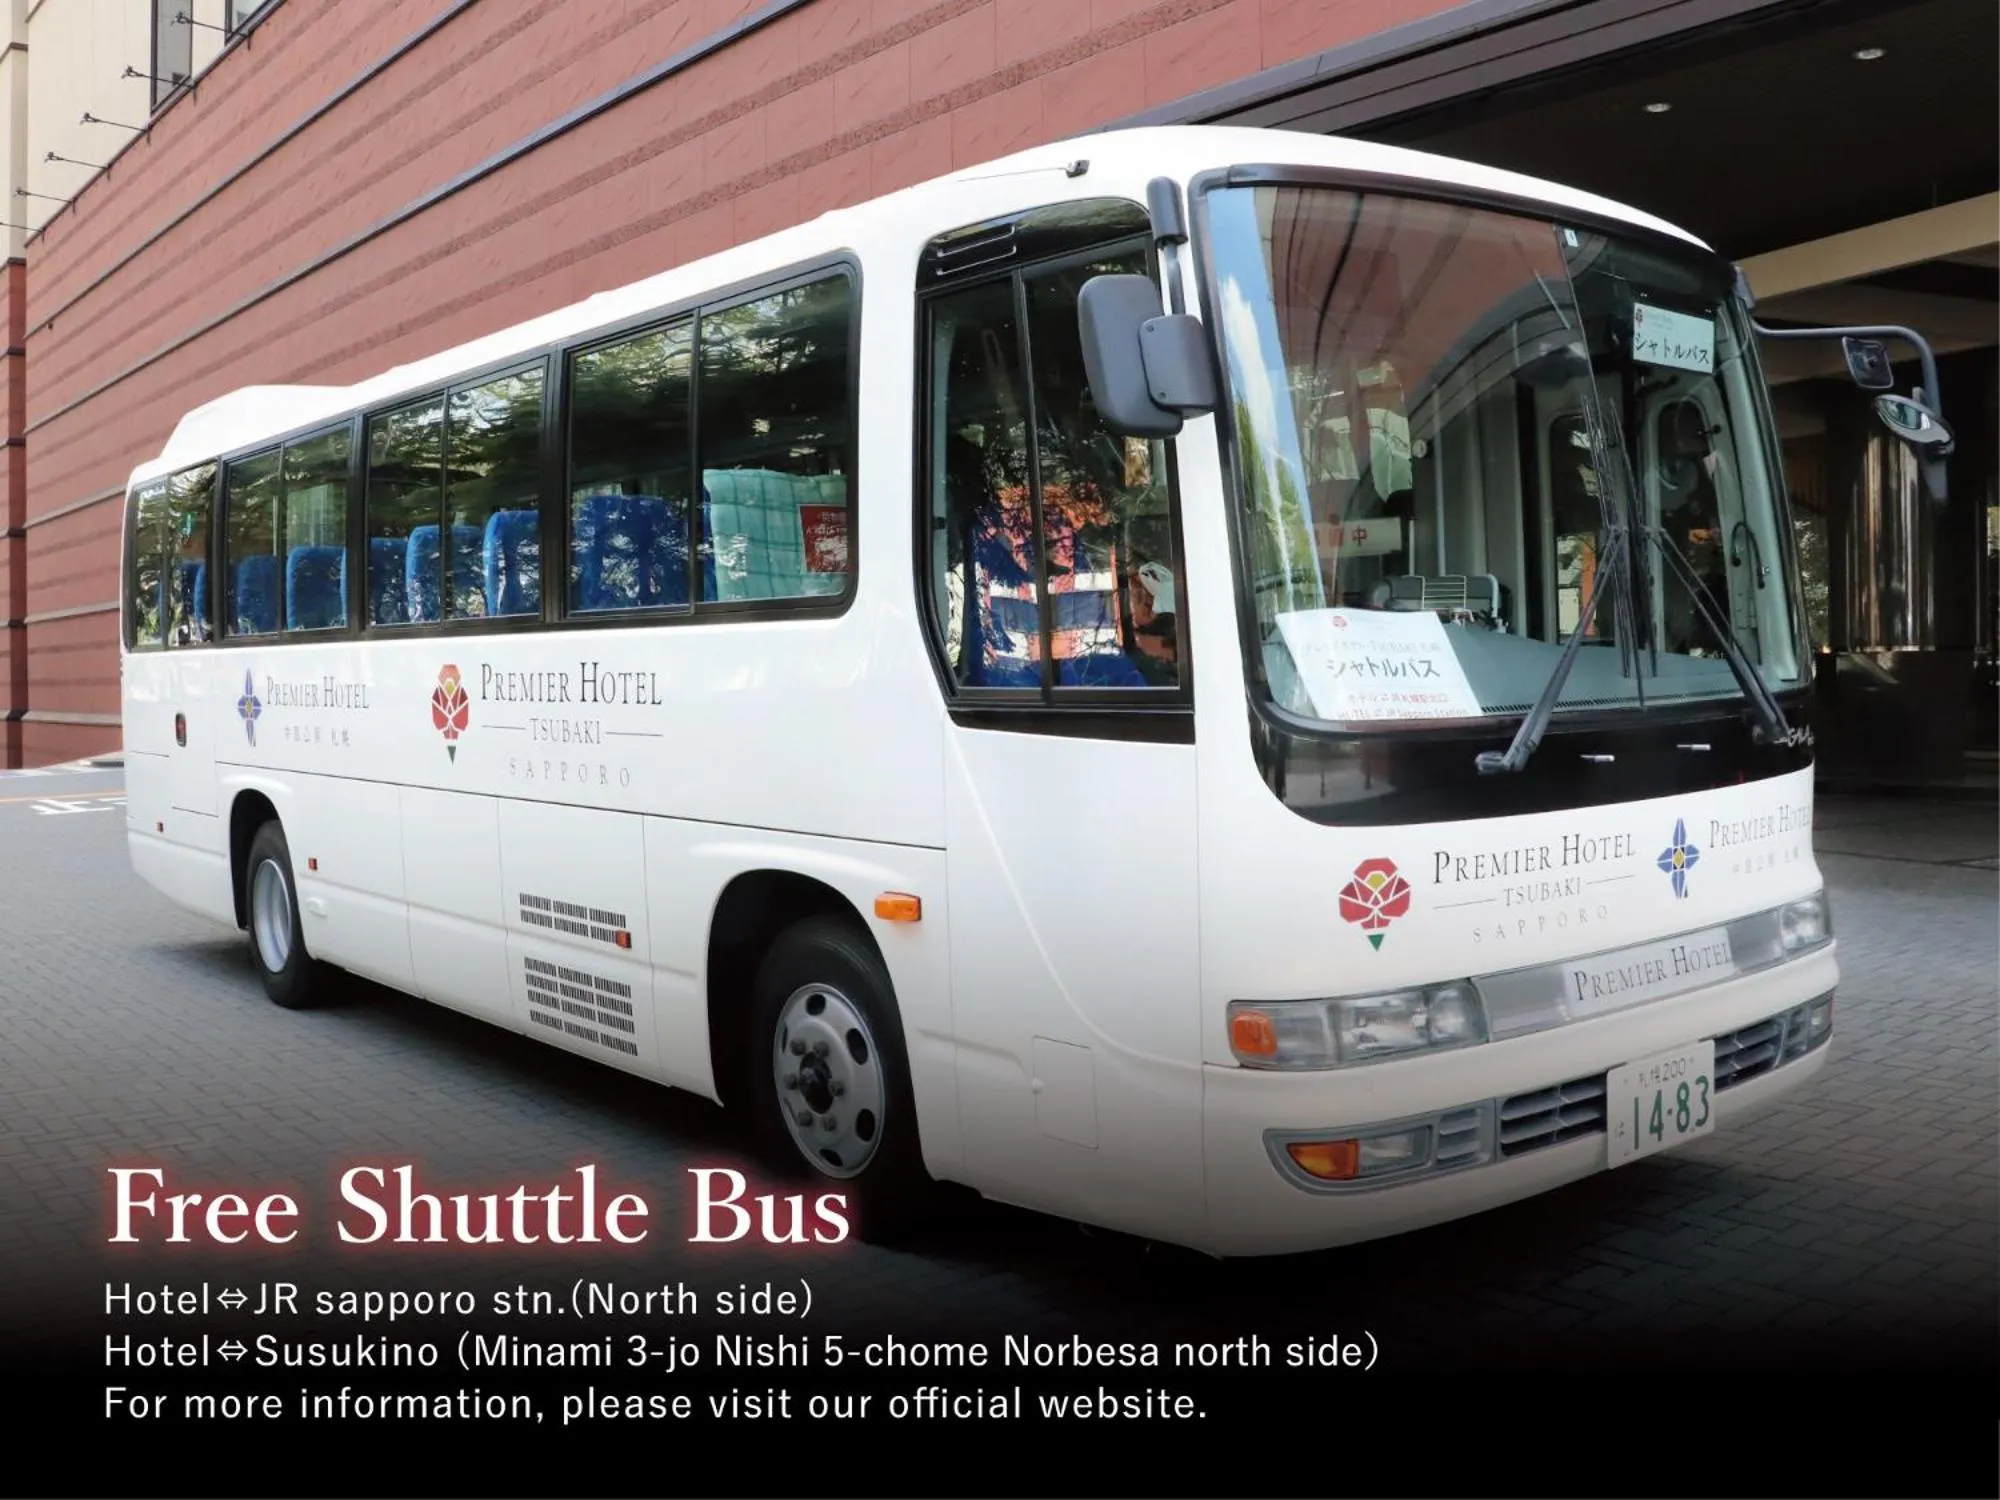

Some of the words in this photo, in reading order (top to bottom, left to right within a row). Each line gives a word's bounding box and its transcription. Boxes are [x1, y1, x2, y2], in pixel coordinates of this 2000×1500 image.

[1635, 334, 1710, 364] シャトルバス
[480, 663, 572, 703] PREMIER
[580, 661, 663, 705] HOTEL
[1325, 656, 1441, 678] シャトルバス
[266, 675, 320, 708] PREMIER
[323, 675, 370, 709] HOTEL
[529, 718, 601, 745] TSUBAKI
[508, 757, 631, 788] SAPPORO
[1709, 815, 1775, 849] PREMIER
[1433, 845, 1552, 884] PREMIER
[1561, 833, 1636, 866] HOTEL
[1503, 877, 1581, 907] TSUBAKI
[1472, 904, 1608, 944] SAPPORO
[1573, 959, 1668, 1001] PREMIER
[1671, 943, 1732, 977] HOTEL
